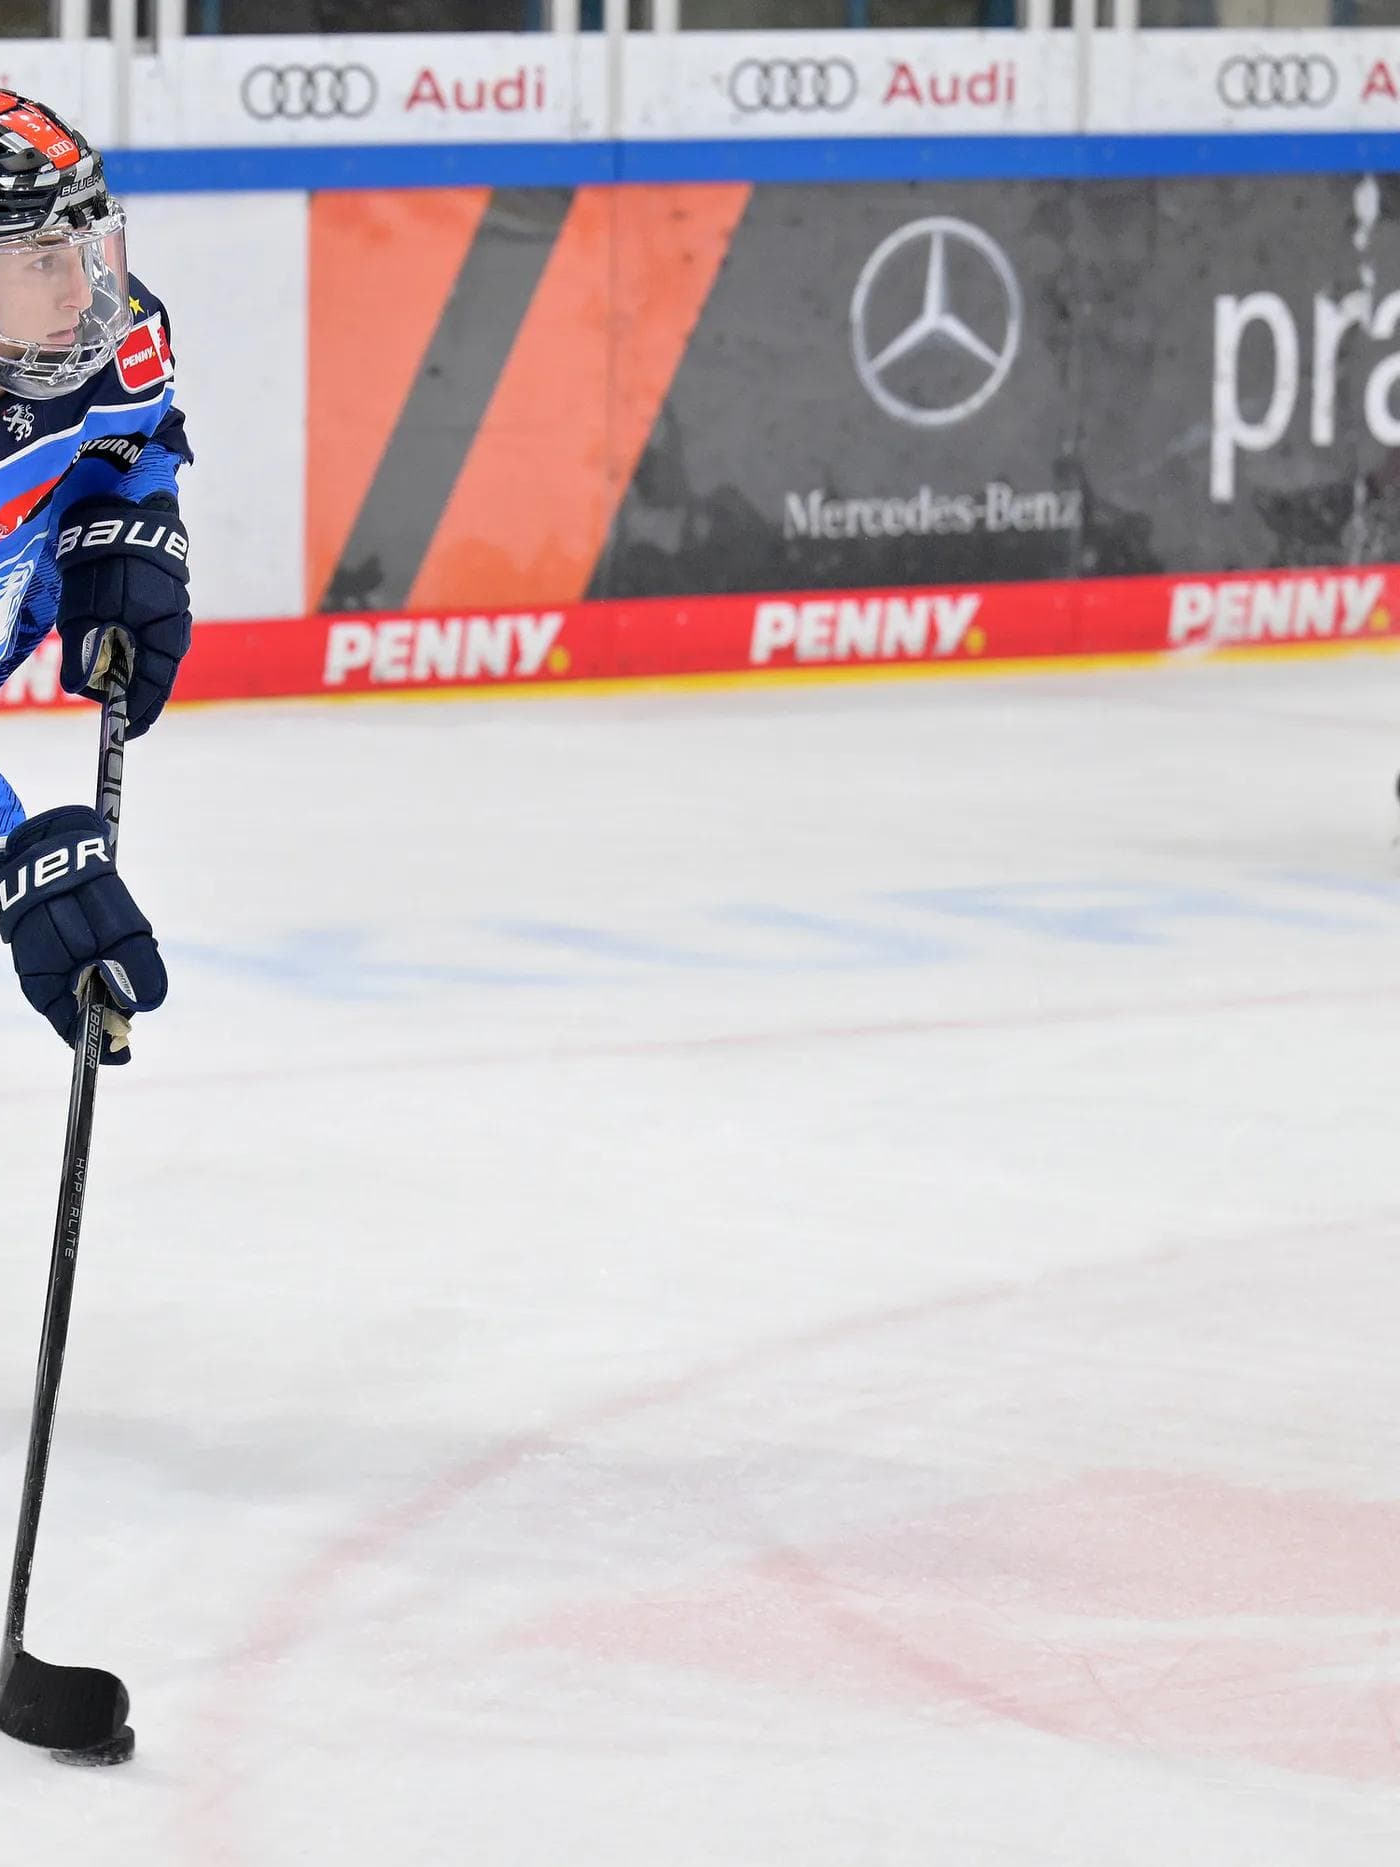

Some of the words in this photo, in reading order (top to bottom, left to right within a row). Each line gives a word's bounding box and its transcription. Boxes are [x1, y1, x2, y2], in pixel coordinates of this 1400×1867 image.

[405, 67, 546, 113] Audi
[883, 61, 1017, 107] Audi
[784, 481, 1082, 540] Mercedes-Benz
[56, 519, 190, 568] BAUE
